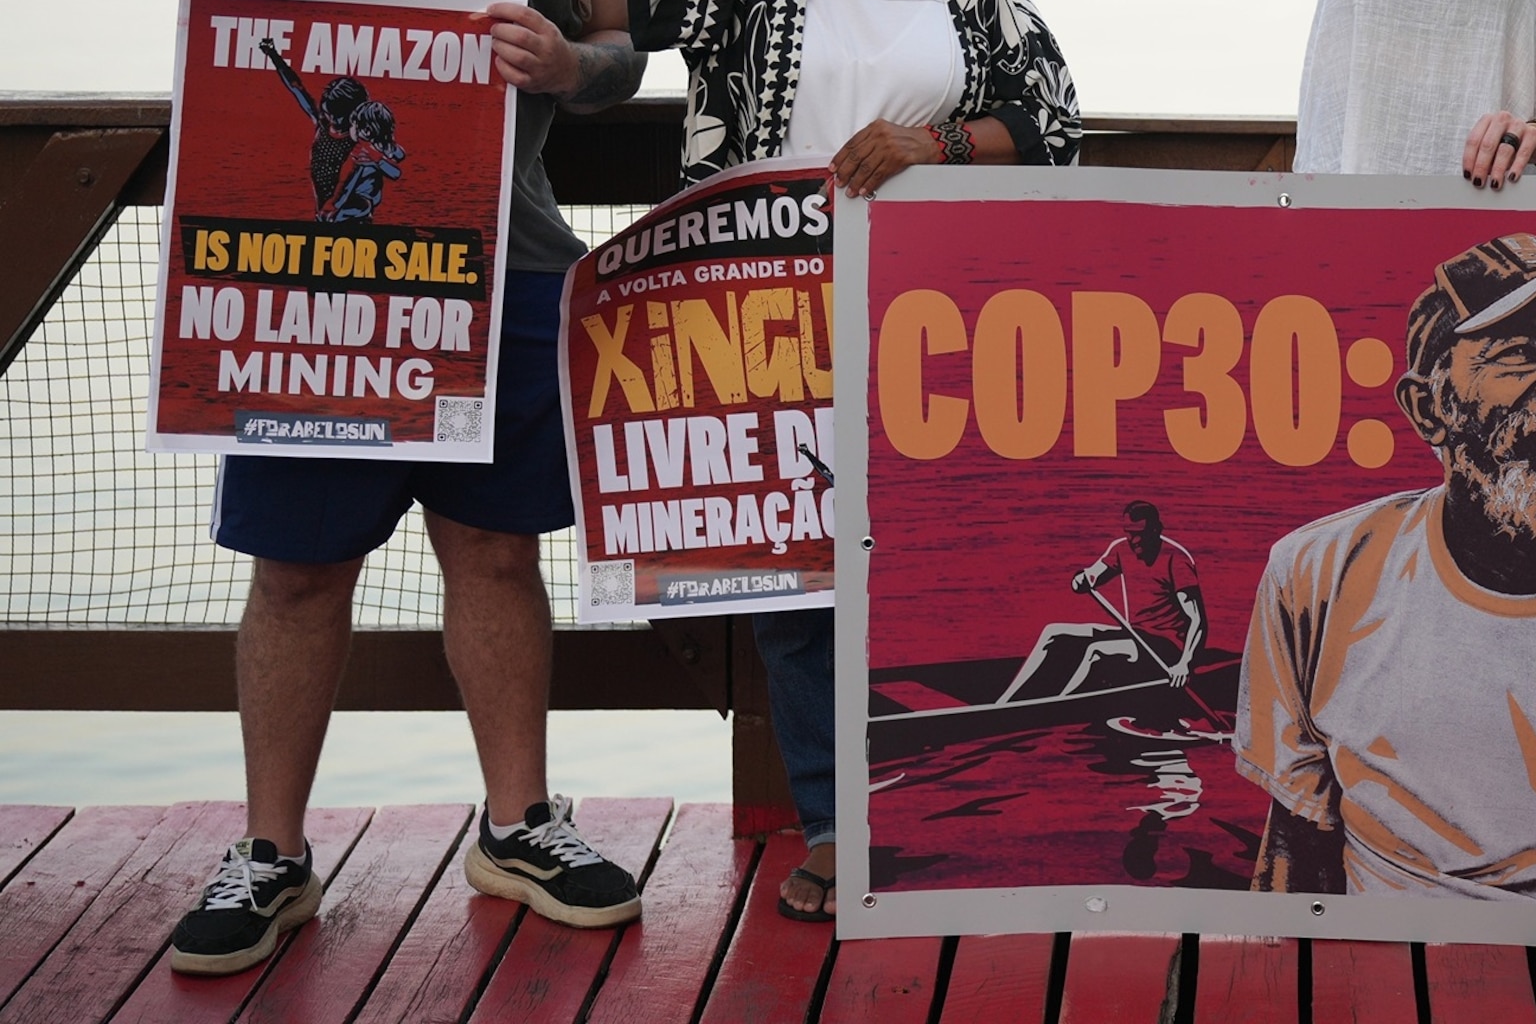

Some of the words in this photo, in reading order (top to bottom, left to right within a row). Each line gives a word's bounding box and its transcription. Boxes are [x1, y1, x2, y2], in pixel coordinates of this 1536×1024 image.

[211, 16, 294, 74] THE
[301, 23, 492, 85] AMAZON
[194, 230, 229, 270] IS
[238, 233, 307, 275] NOT
[312, 236, 376, 280] FOR
[385, 241, 478, 284] SALE.
[597, 194, 829, 275] QUEREMOS
[596, 289, 612, 305] A
[619, 270, 687, 295] VOLTA
[694, 260, 787, 282] GRANDE
[794, 258, 824, 275] DO
[179, 285, 244, 342] NO
[255, 290, 376, 347] LAND
[386, 296, 473, 352] FOR
[218, 350, 434, 400] MINING
[877, 288, 1395, 469] COP30:
[244, 418, 385, 441] #FORABELOSUN
[593, 413, 764, 493] LIVRE
[667, 572, 798, 599] #FORABELOSUN
